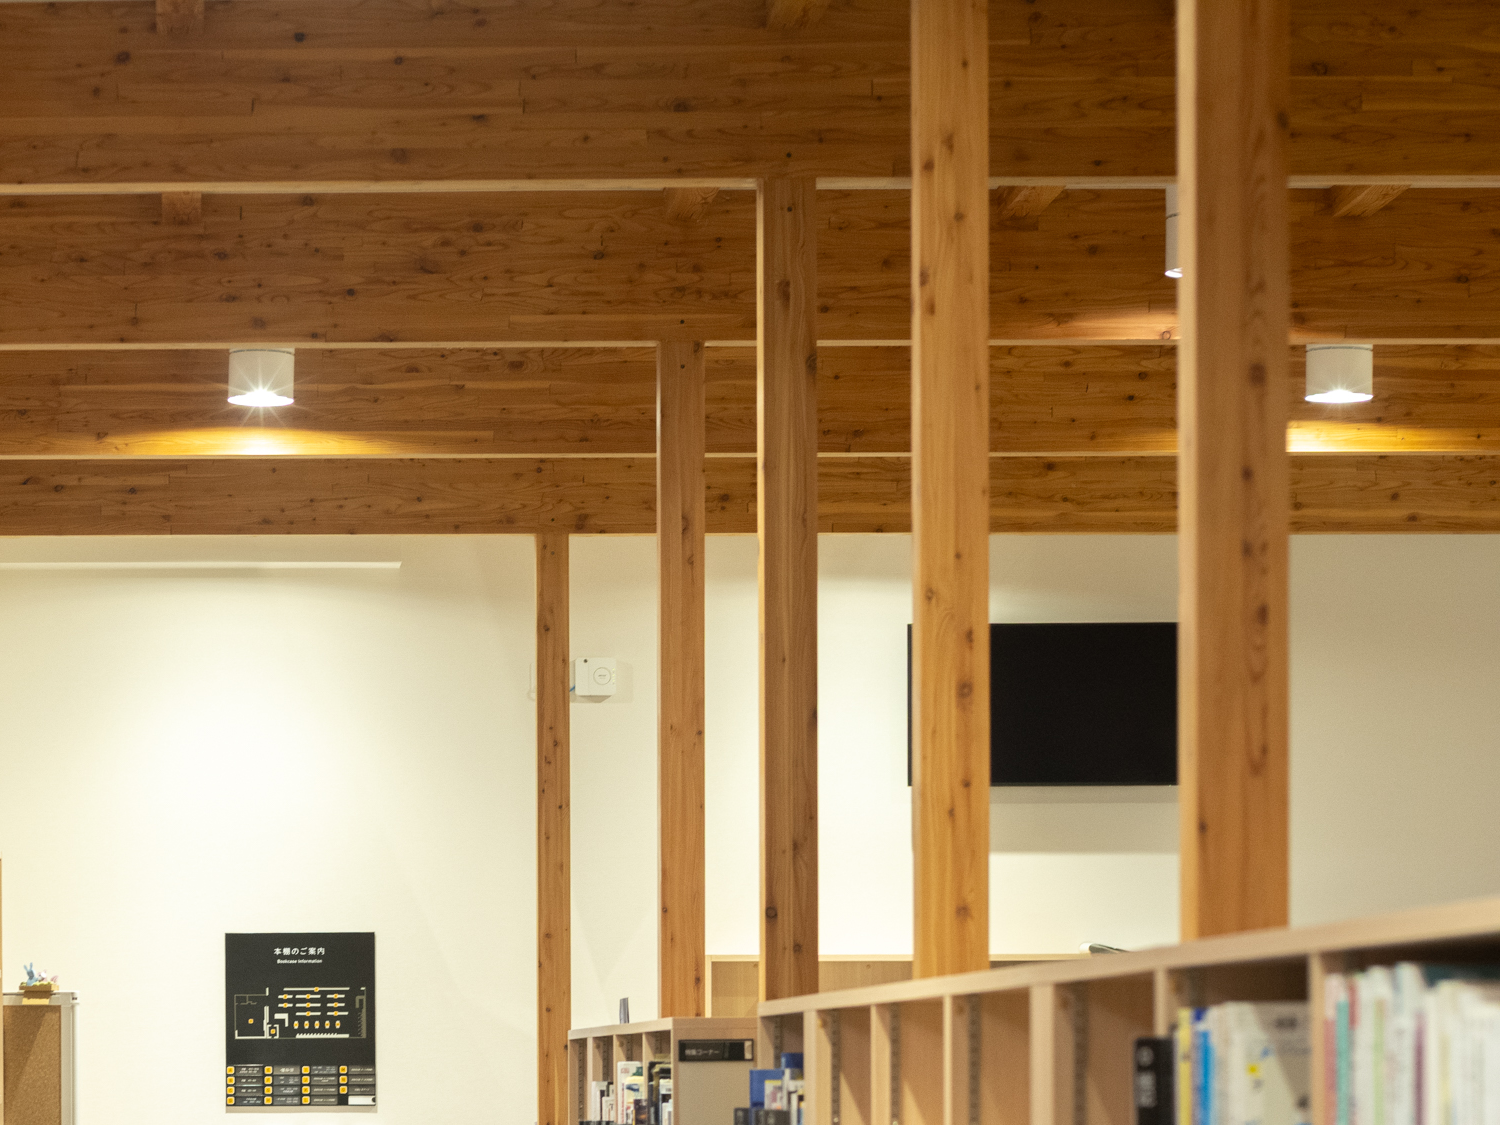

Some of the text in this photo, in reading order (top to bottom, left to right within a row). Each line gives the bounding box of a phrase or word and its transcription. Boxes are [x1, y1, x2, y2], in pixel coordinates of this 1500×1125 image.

[273, 947, 326, 956] 本棚のご案内
